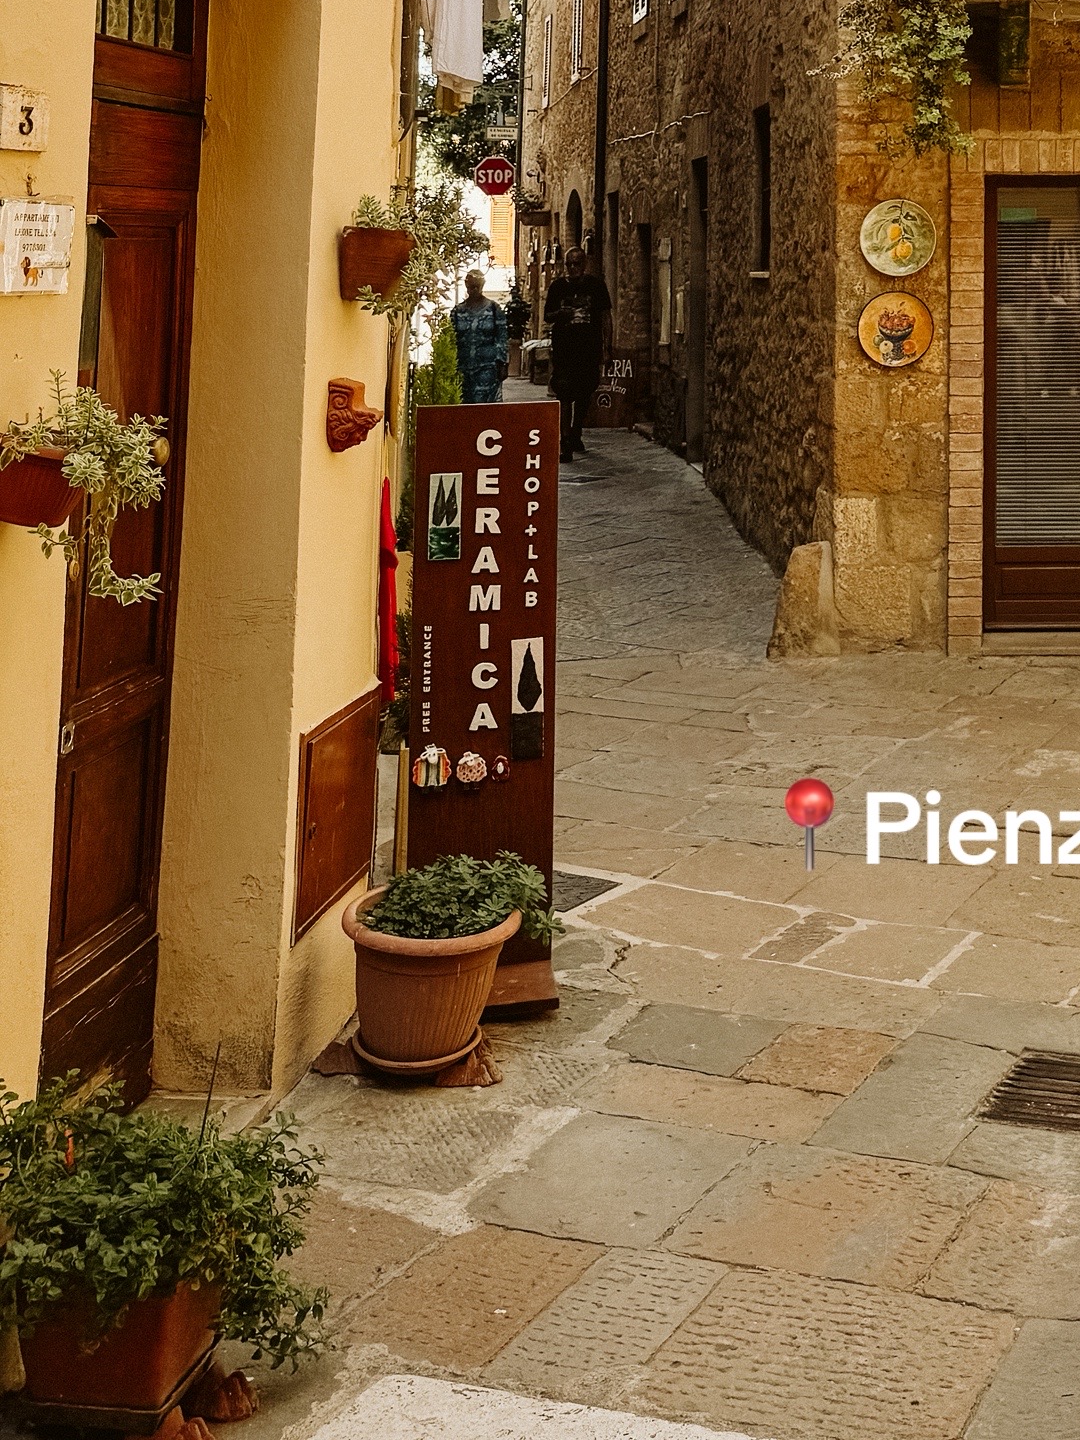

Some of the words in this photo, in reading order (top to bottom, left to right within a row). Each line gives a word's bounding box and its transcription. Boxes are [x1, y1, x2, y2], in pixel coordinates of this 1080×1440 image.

[19, 106, 34, 136] 3
[478, 169, 513, 184] STOP
[14, 213, 60, 223] APPARTAMEO
[469, 429, 502, 731] CERAMICA
[423, 625, 433, 693] ENTRANCE
[422, 701, 431, 733] FREE
